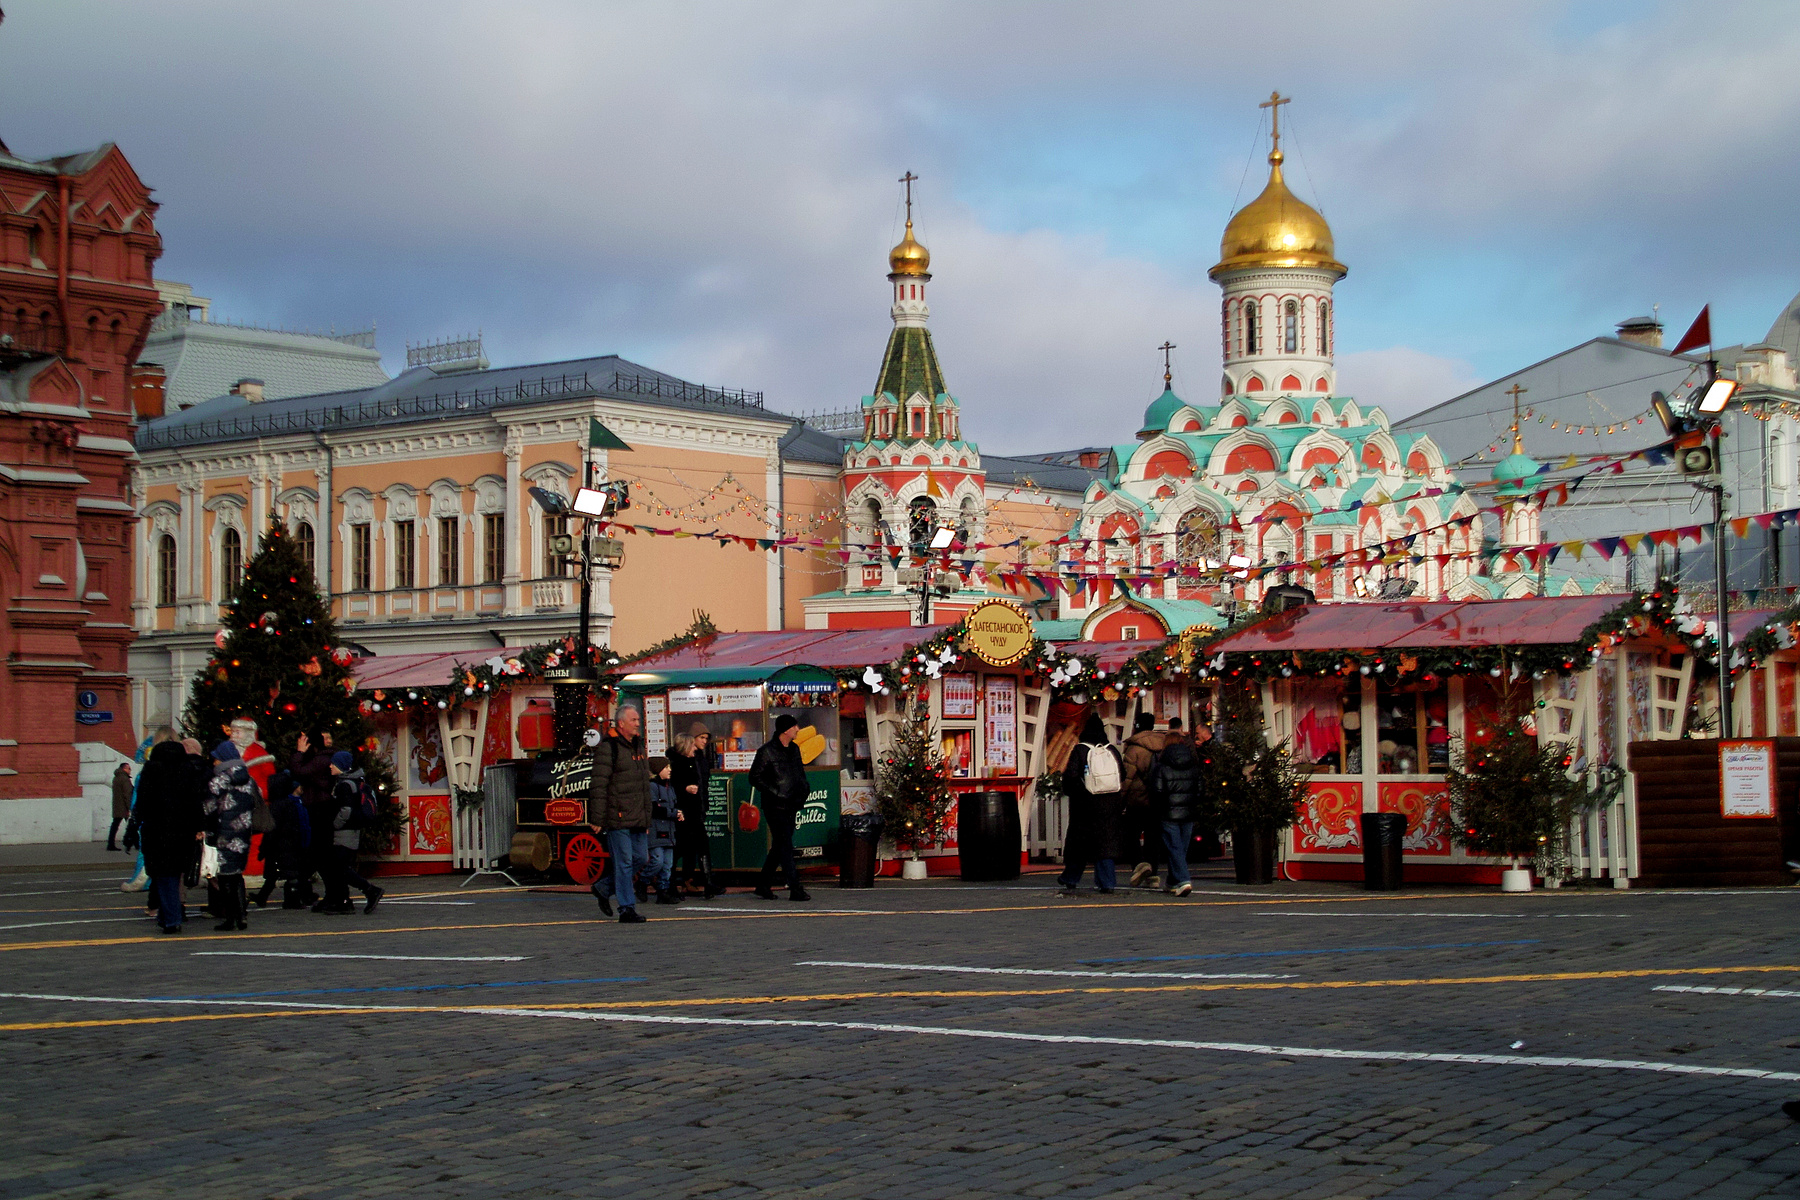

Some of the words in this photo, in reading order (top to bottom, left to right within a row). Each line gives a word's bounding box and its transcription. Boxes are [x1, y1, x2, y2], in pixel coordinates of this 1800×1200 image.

[973, 621, 1024, 634] ДАГЕСТАНСКОЕ
[989, 636, 1007, 647] ЧУДУ
[772, 684, 799, 692] ГОРЯЧИЕ
[803, 684, 832, 692] НАПИТКИ
[87, 694, 92, 705] 1
[795, 808, 827, 830] Grilles
